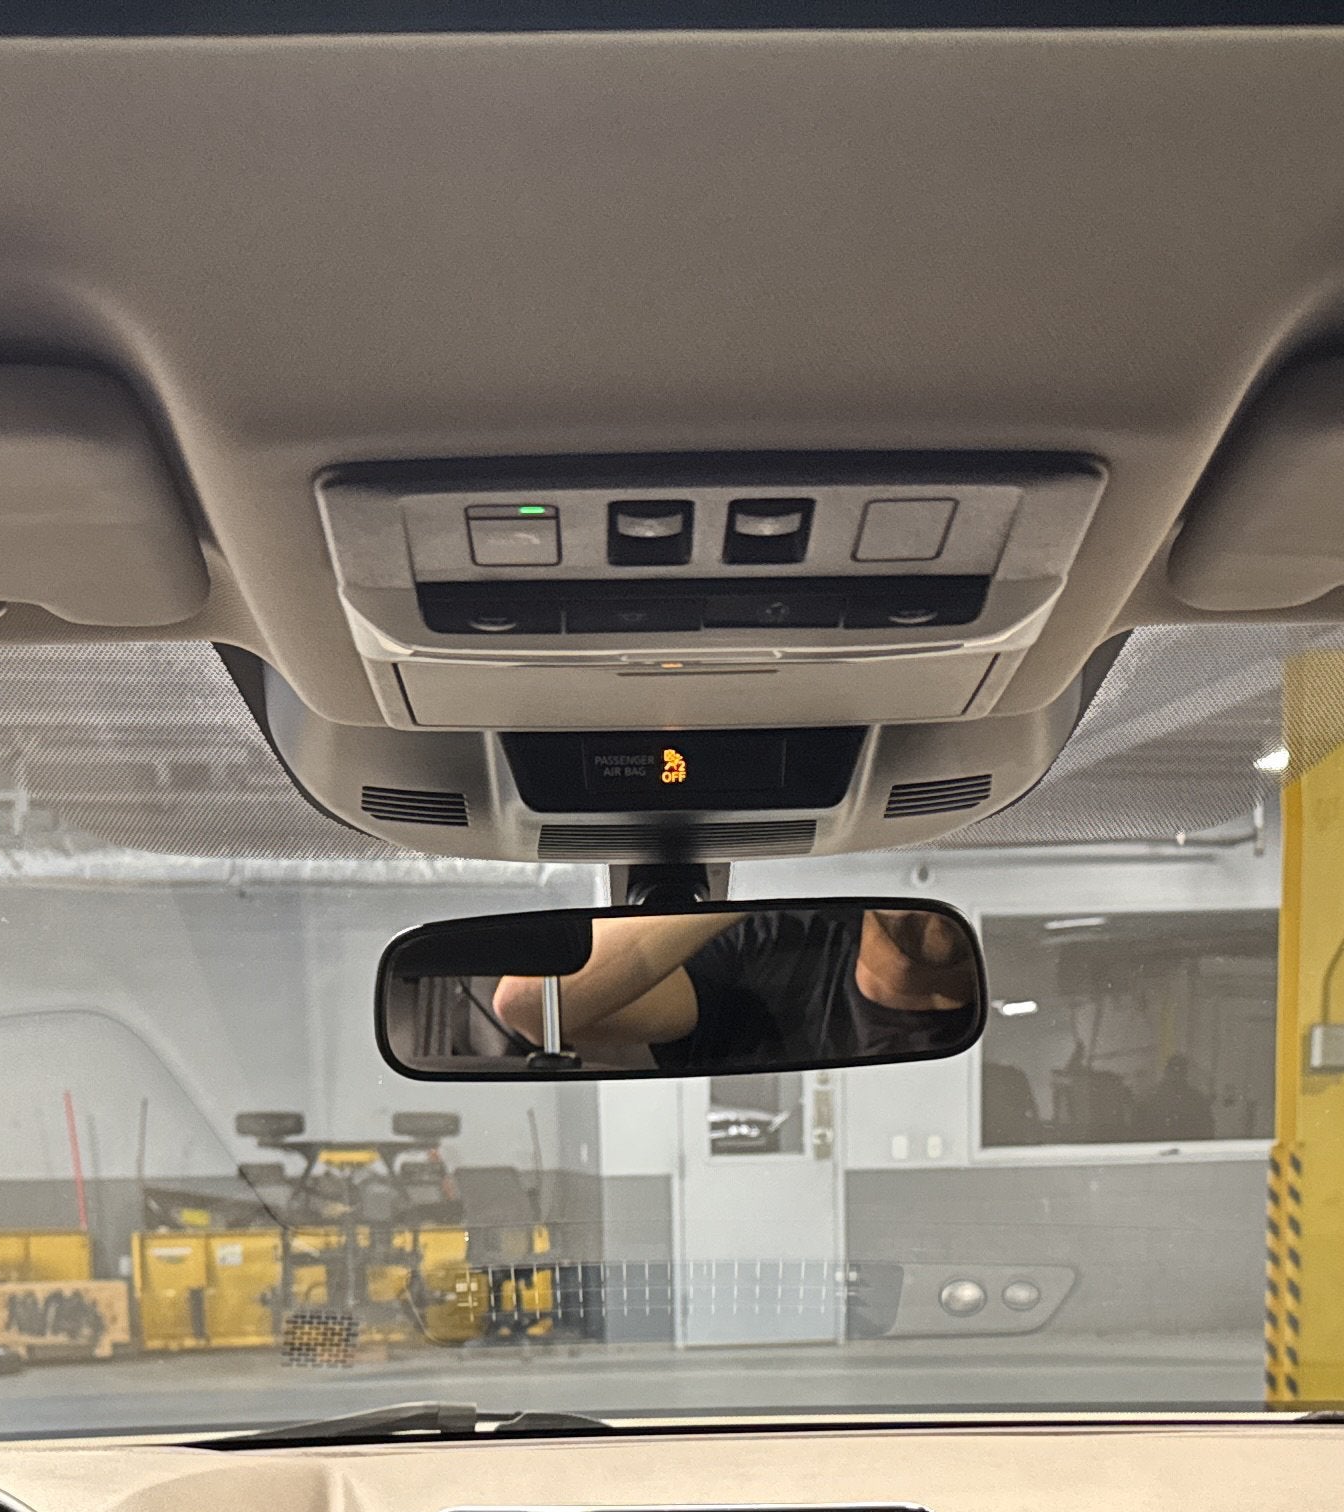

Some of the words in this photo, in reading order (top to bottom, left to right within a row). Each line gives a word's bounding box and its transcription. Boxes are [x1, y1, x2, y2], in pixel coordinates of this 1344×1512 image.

[594, 755, 655, 766] PASSENGER
[603, 767, 622, 776] AIR
[624, 767, 646, 776] BAG
[661, 771, 687, 783] OFF
